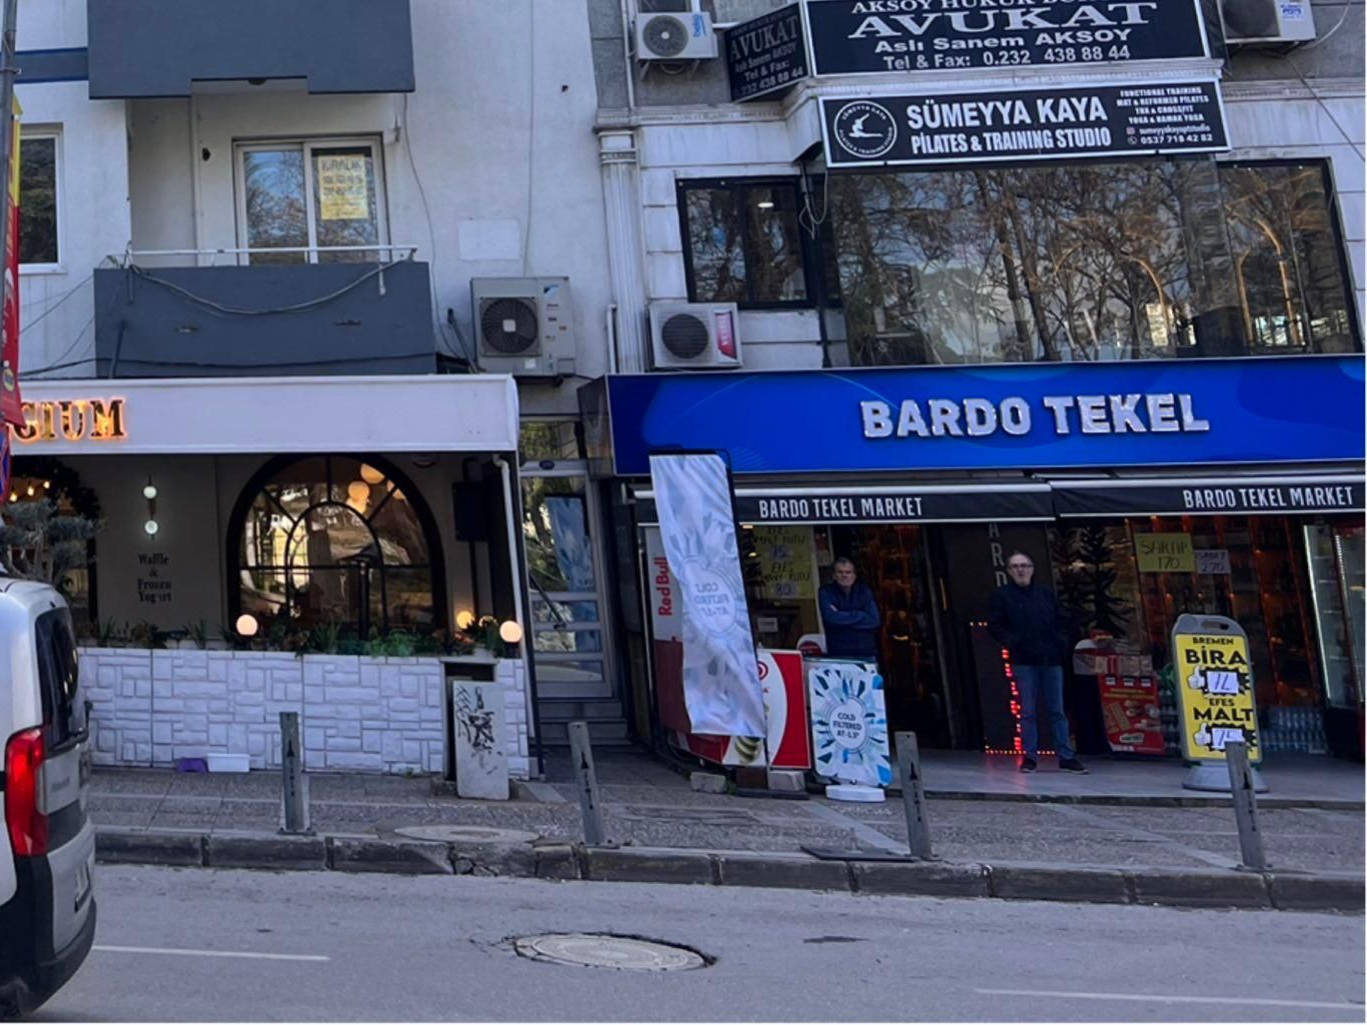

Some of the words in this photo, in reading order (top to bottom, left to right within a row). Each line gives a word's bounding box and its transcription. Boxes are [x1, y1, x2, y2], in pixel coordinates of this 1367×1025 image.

[848, 2, 1158, 39] AVUKAT
[731, 16, 798, 61] AVUKAT
[875, 39, 924, 53] Aslı
[933, 35, 1025, 51] Sanem
[1035, 29, 1132, 46] AKSOY
[884, 55, 910, 70] Tel
[916, 54, 929, 69] &
[934, 53, 971, 68] Fax:
[983, 50, 1032, 66] 0.232
[1044, 47, 1075, 63] 438
[1082, 46, 1103, 61] 88
[1108, 45, 1130, 60] 44
[906, 99, 1032, 129] SÜMEYYA
[1036, 96, 1108, 123] KAYA
[911, 132, 968, 154] PİLATES
[970, 134, 982, 151] &
[983, 129, 1055, 151] TRAINING
[1056, 127, 1112, 149] STUDIO
[860, 396, 1032, 438] BARDO
[1043, 393, 1210, 434] TEKEL
[758, 498, 809, 519] BARDO
[812, 497, 857, 518] TEKEL
[860, 496, 923, 517] MARKET
[1183, 488, 1236, 508] BARDO
[1238, 487, 1286, 508] TEKEL
[1289, 486, 1353, 506] MARKET
[138, 552, 169, 565] Waffle
[654, 556, 670, 585] Bull
[659, 587, 672, 616] Red
[1192, 637, 1234, 645] BREMEN
[1185, 646, 1248, 665] BİRA
[1193, 707, 1254, 722] MALT
[1209, 698, 1235, 707] EFES
